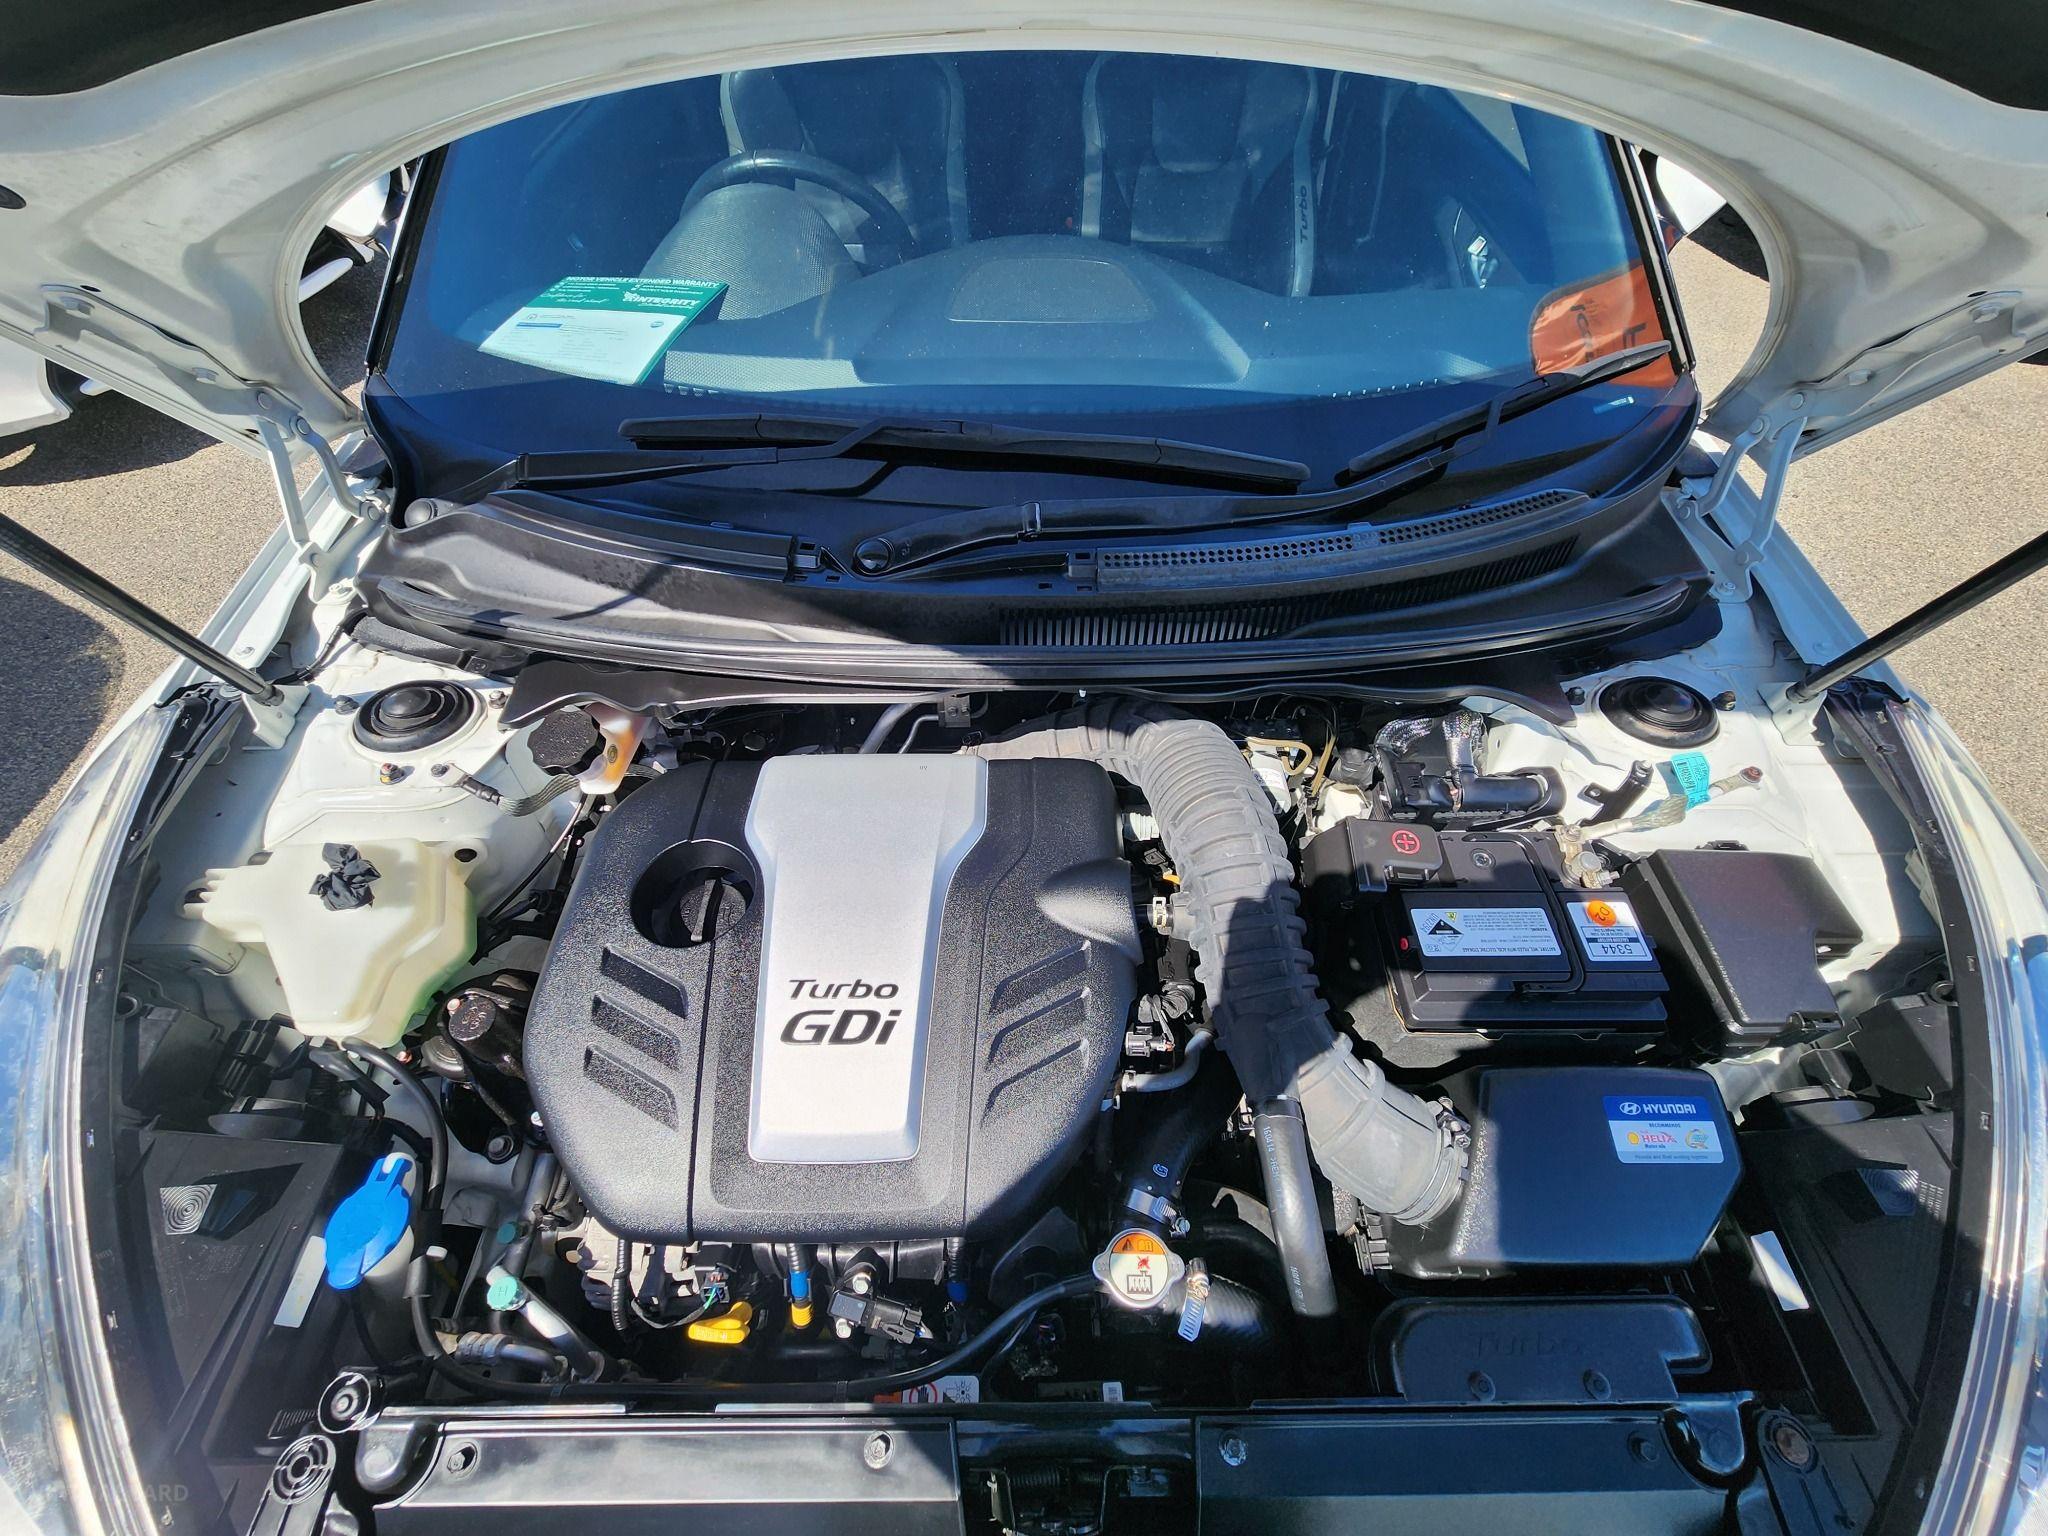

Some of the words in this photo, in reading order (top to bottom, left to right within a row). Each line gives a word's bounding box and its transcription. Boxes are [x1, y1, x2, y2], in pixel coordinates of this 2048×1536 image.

[1298, 185, 1308, 244] Turbo
[628, 278, 671, 286] EXTENDED
[672, 279, 720, 288] WARRANTY
[633, 296, 700, 306] INTEGRITY
[1602, 944, 1632, 954] 5344
[789, 979, 899, 999] Turbo
[780, 1010, 902, 1045] GDi
[1643, 1104, 1696, 1114] HYUNDAI
[1641, 1134, 1677, 1143] HELIX
